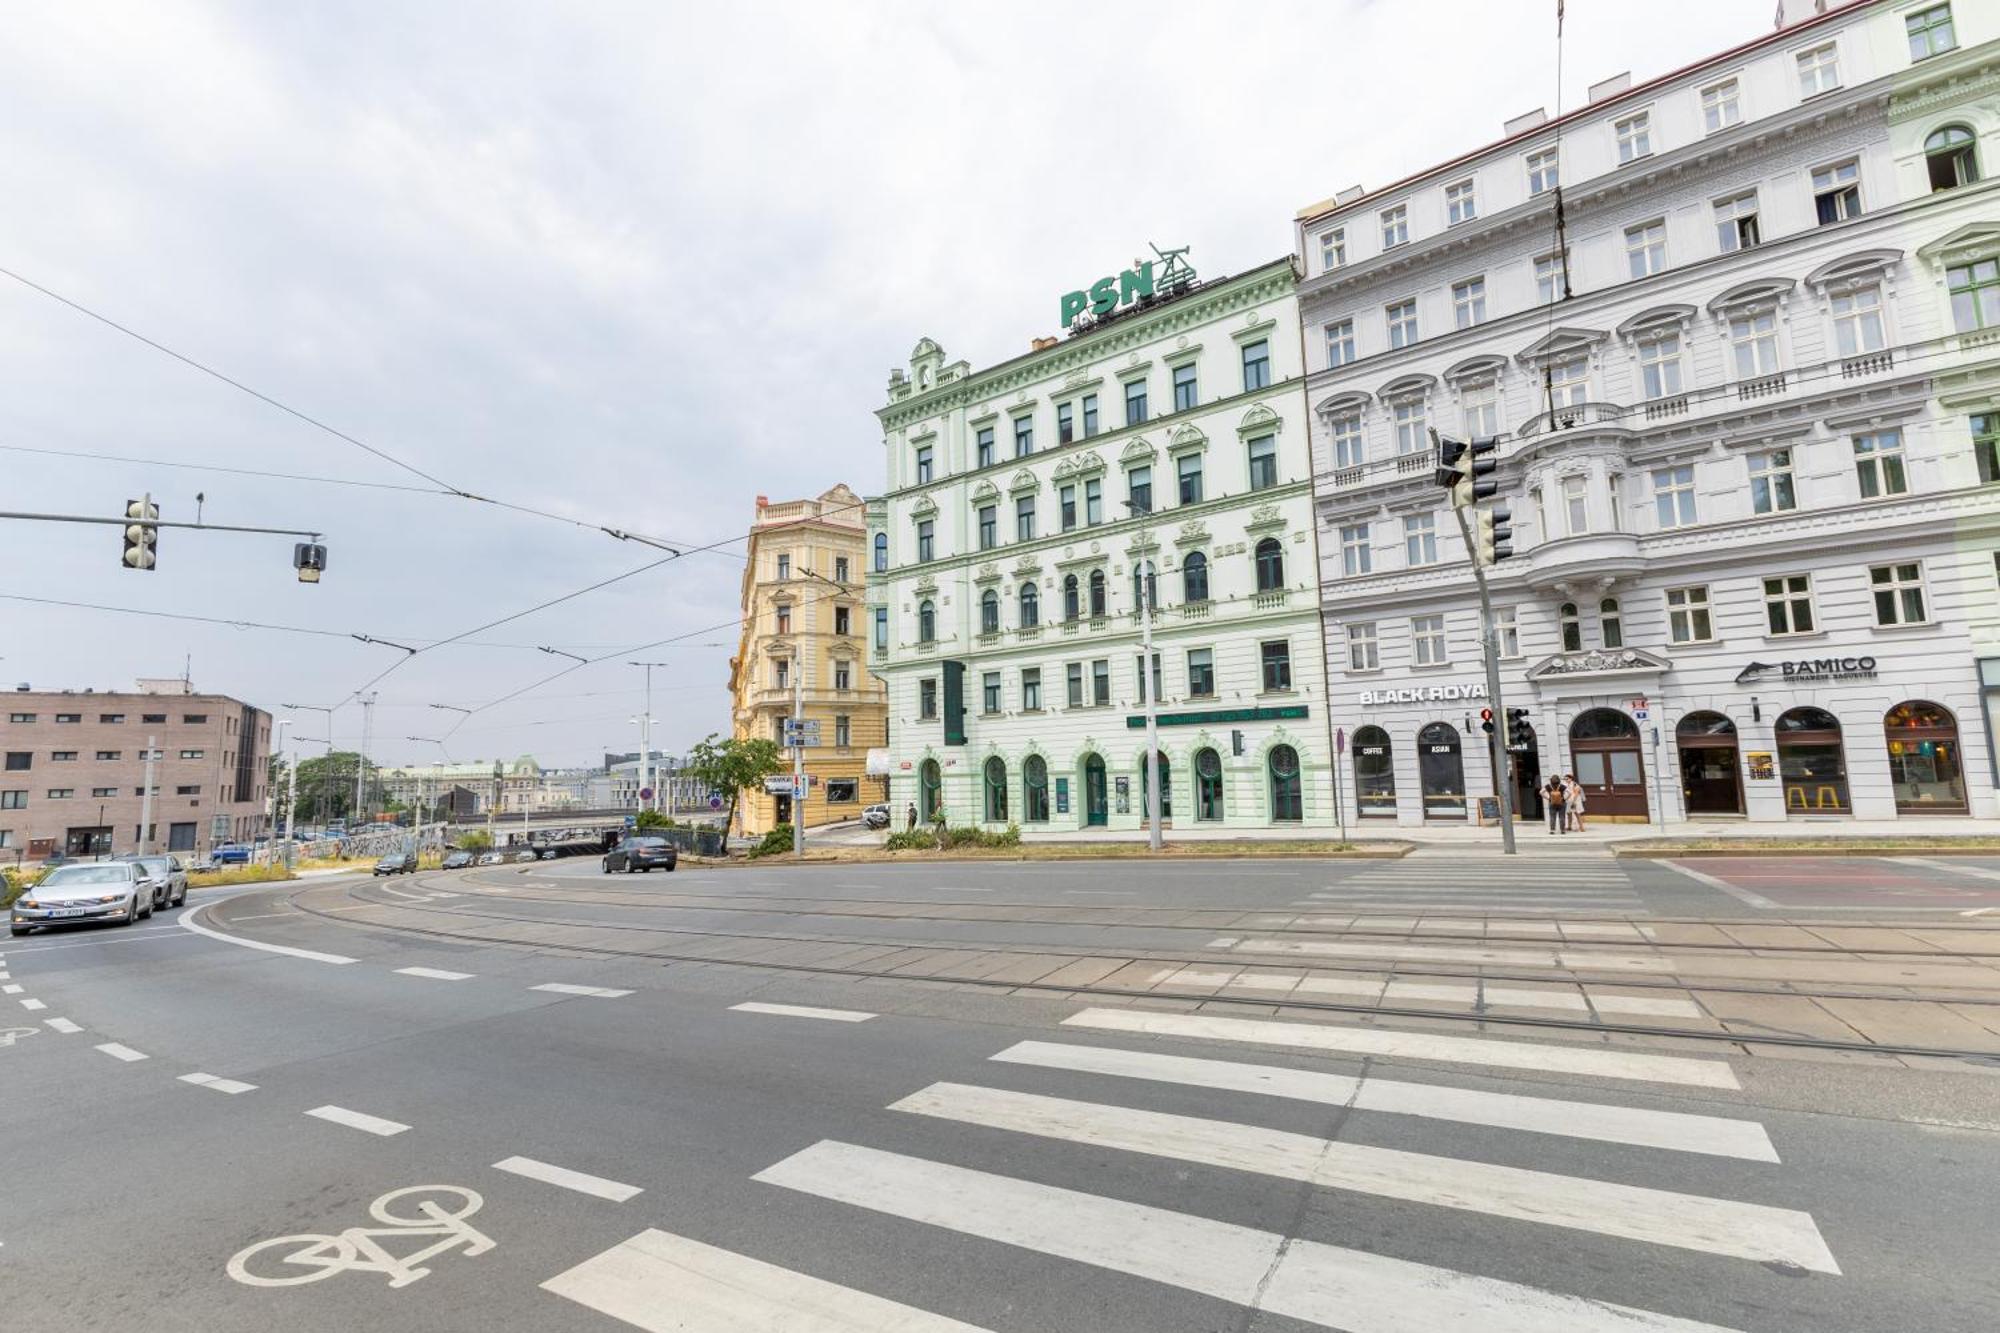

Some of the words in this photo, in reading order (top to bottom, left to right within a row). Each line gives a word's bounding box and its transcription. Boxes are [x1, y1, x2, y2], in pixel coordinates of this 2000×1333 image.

[1060, 260, 1154, 329] PSN
[1781, 656, 1876, 675] BAMICO
[1359, 689, 1424, 705] BLACK
[1429, 684, 1489, 701] ROYA
